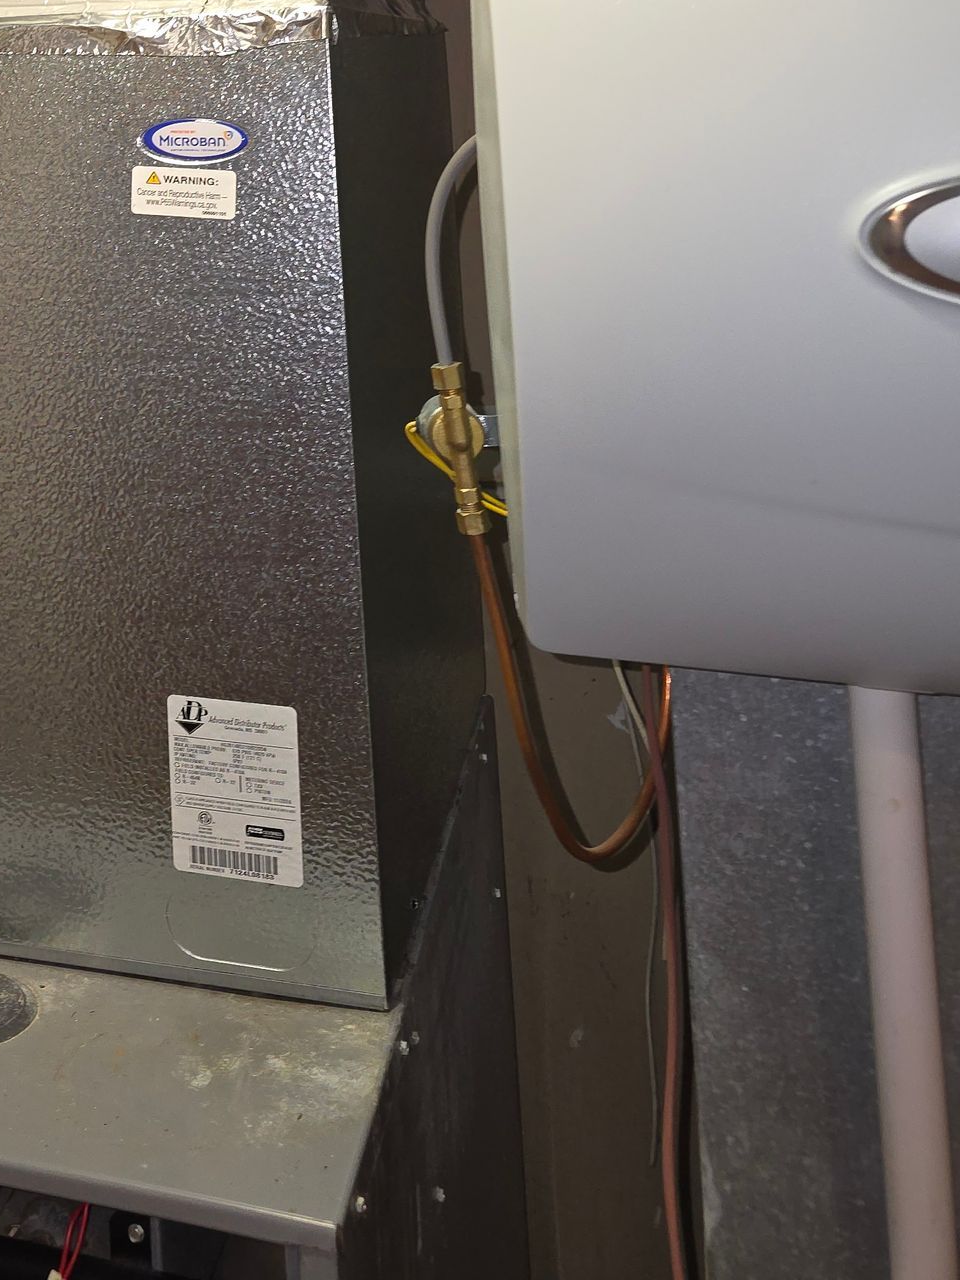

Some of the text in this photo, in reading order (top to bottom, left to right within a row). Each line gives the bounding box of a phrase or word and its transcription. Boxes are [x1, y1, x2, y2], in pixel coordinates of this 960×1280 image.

[163, 175, 219, 186] WARNING:
[136, 187, 157, 197] Cancer
[157, 189, 168, 197] and
[176, 700, 209, 722] ADP
